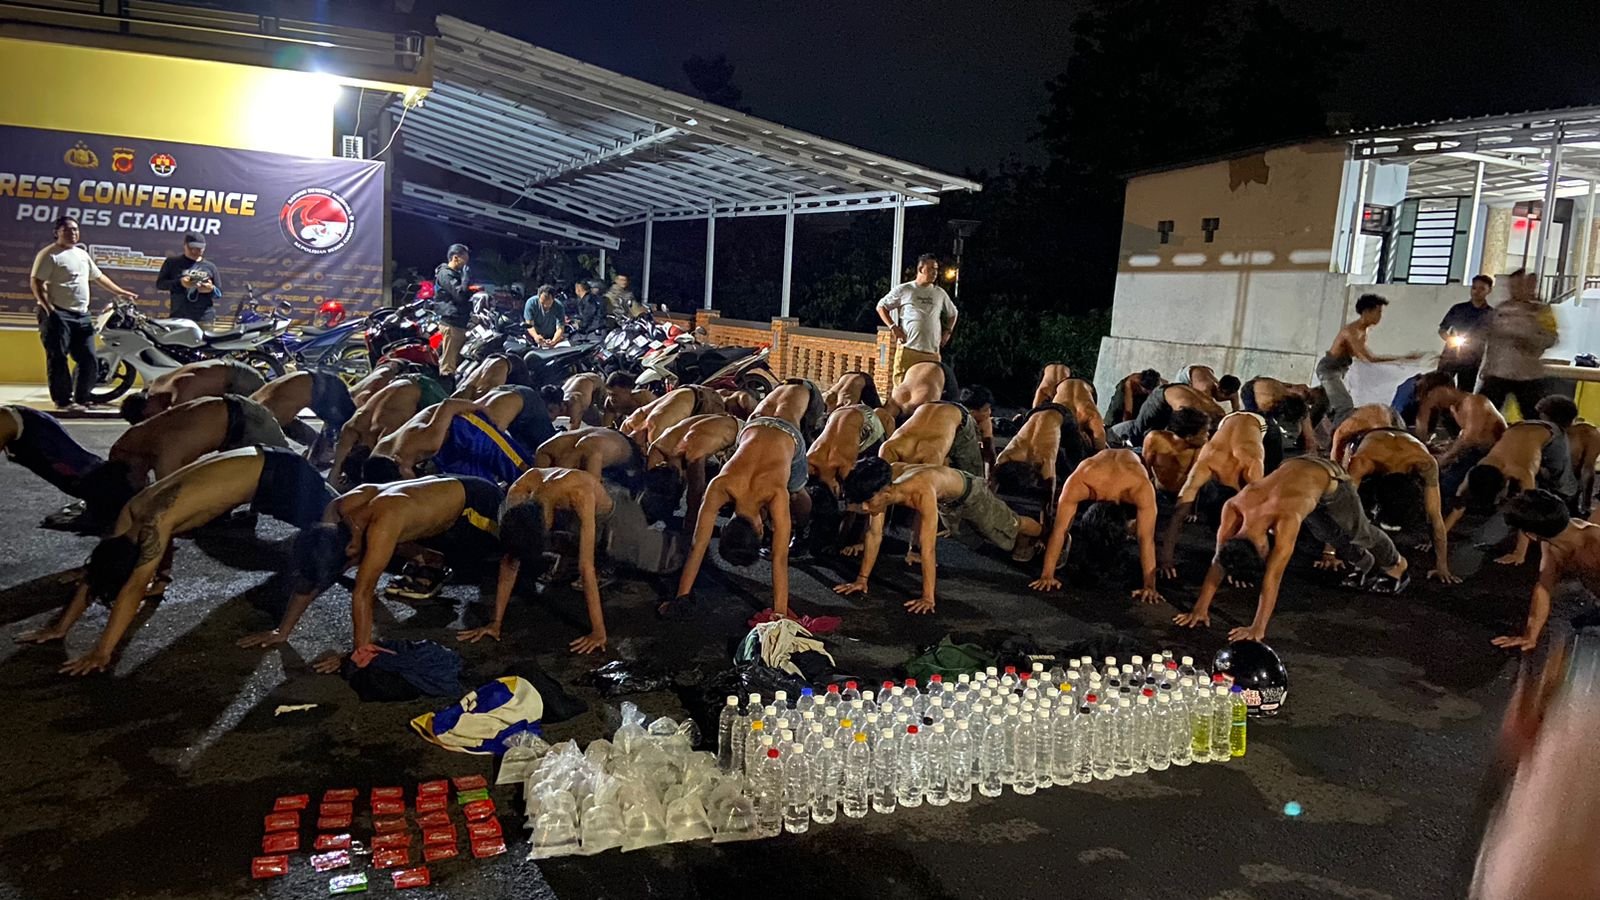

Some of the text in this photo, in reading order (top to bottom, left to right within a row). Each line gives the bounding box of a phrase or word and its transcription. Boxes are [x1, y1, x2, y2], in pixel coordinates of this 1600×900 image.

[0, 172, 258, 217] RESS CONFERENCE
[16, 203, 221, 236] POLRES CIANJUR
[95, 255, 164, 267] PRESIS
